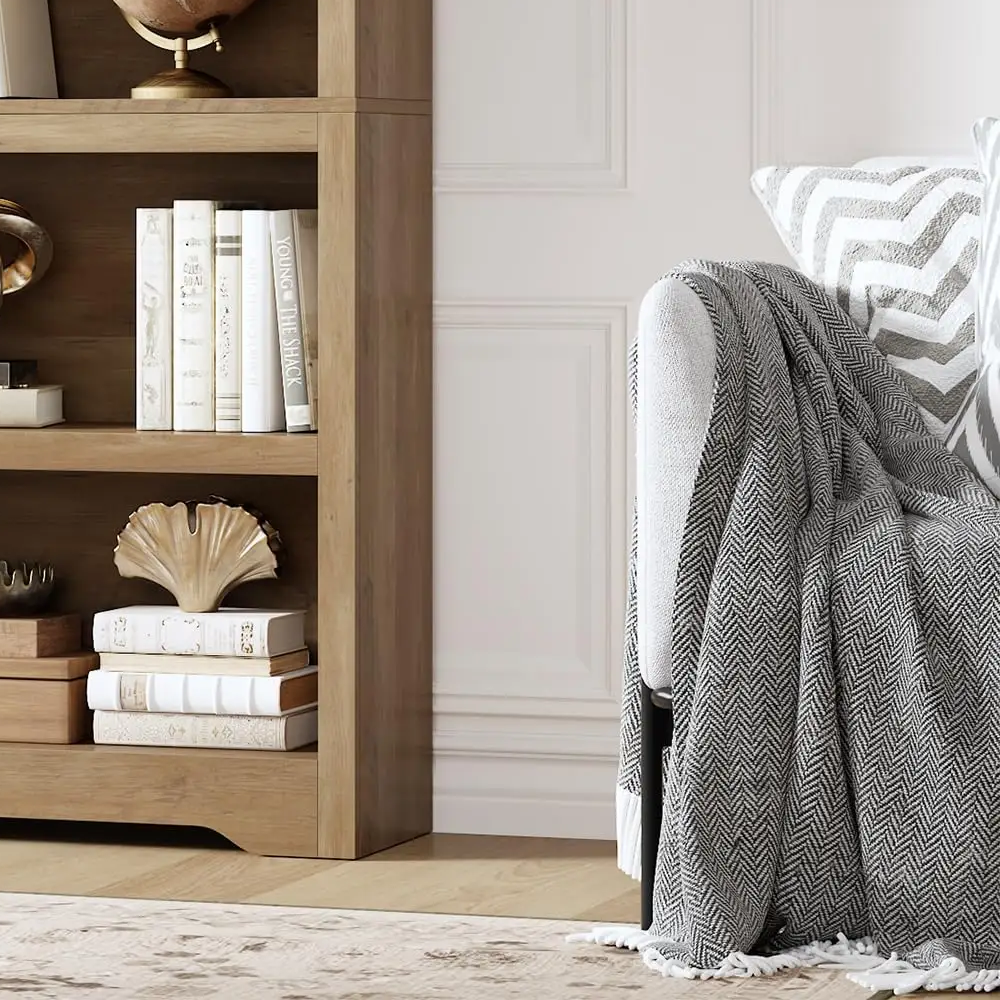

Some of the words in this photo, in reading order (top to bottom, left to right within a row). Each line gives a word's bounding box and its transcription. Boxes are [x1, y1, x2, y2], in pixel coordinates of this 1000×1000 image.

[276, 236, 293, 289] YOUNG
[280, 304, 298, 336] THE
[283, 337, 302, 386] SHACK
